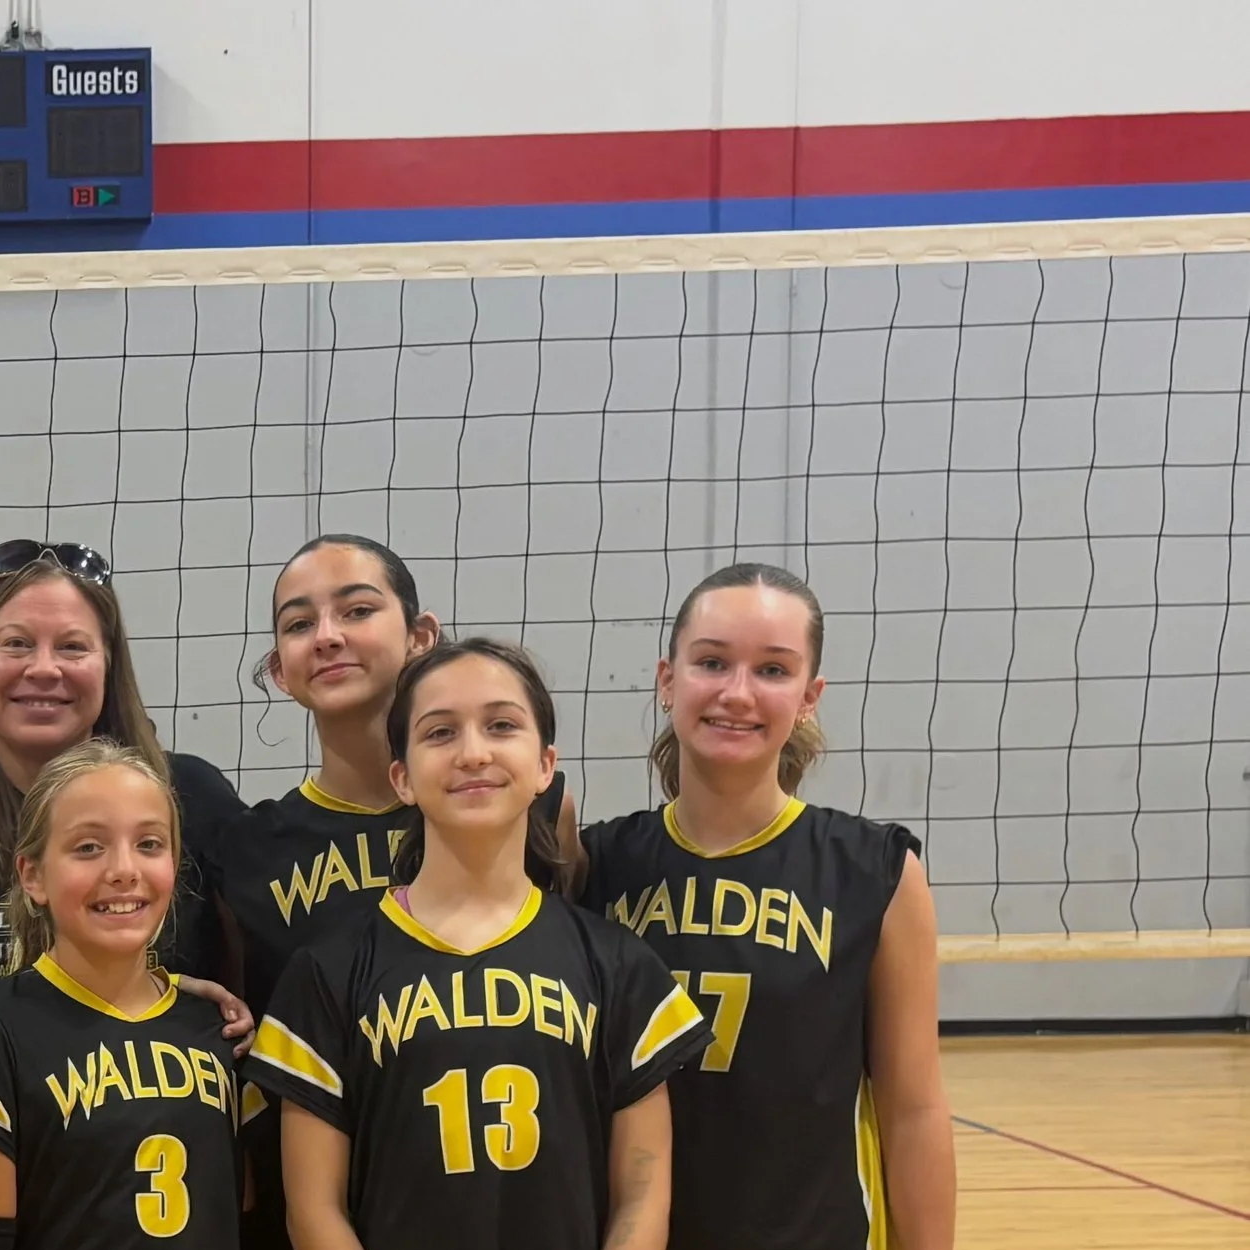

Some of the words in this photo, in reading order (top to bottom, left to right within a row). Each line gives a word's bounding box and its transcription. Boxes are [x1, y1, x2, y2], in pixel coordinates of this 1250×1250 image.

[52, 65, 139, 96] Guests
[269, 829, 408, 927] WAL
[358, 967, 598, 1068] WALDEN
[670, 969, 752, 1072] 7
[44, 1040, 239, 1138] WALDEN
[422, 1063, 541, 1175] 13
[134, 1133, 191, 1238] 3
